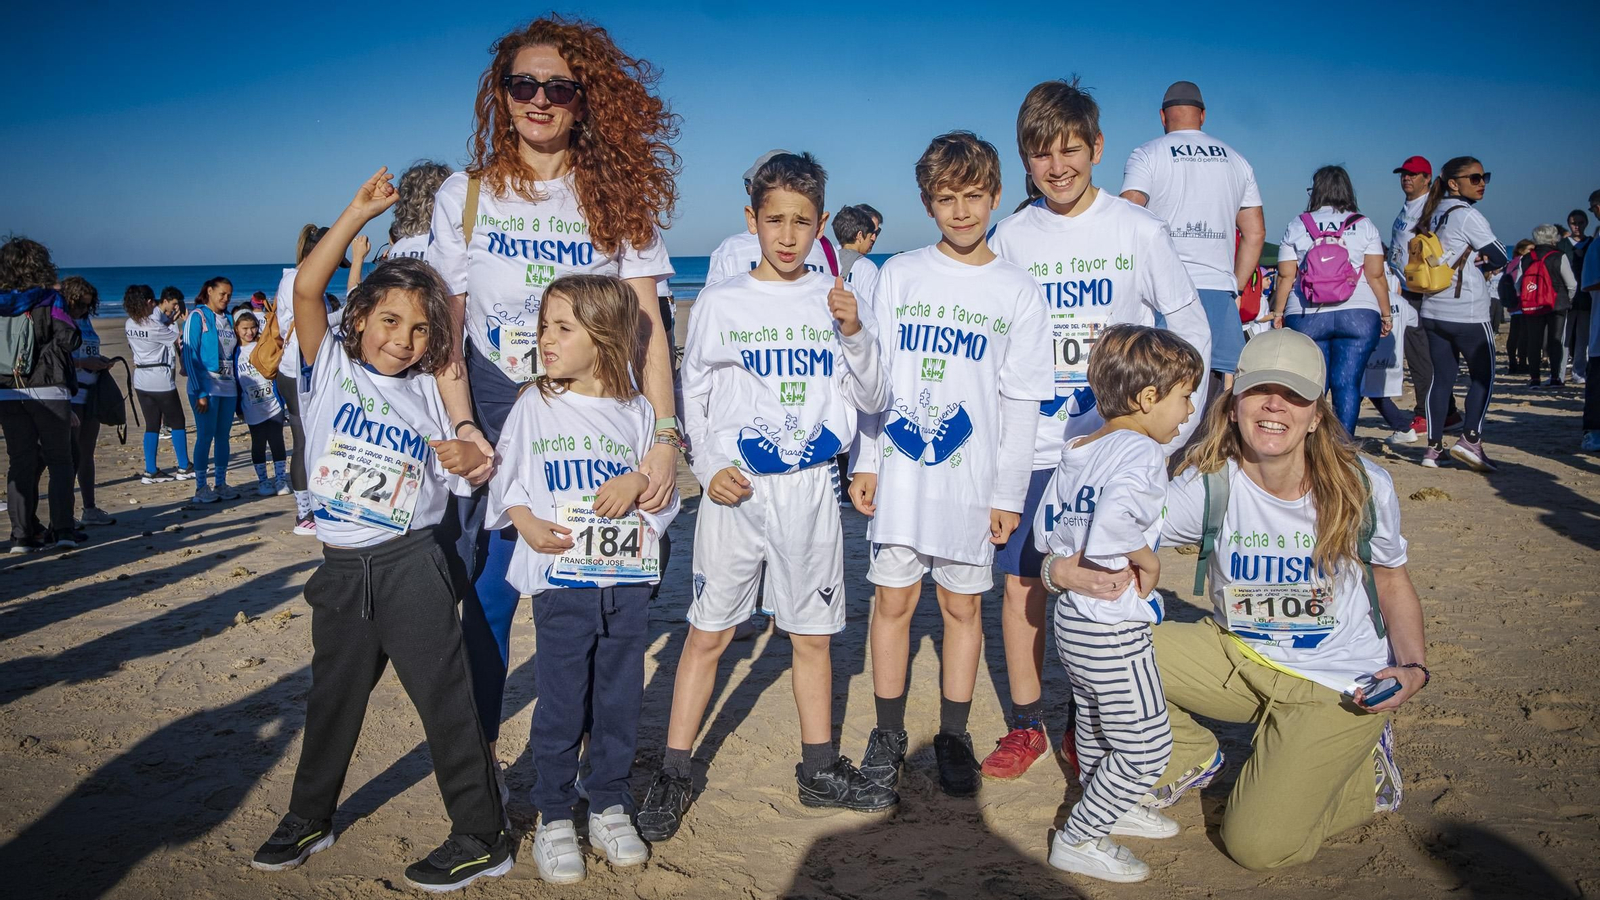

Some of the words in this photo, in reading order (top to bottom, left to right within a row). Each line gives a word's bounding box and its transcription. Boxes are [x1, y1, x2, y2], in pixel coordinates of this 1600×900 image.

[1170, 145, 1227, 157] KIABI
[533, 217, 540, 232] a
[548, 216, 587, 235] favor
[488, 232, 593, 266] AUTISMO
[1055, 261, 1063, 275] a
[1070, 257, 1107, 273] favor
[1115, 253, 1134, 271] del
[1042, 278, 1113, 309] TISMO
[493, 303, 525, 327] Cada
[937, 305, 945, 319] a
[953, 305, 988, 326] favor
[993, 316, 1012, 336] del
[729, 326, 778, 343] marcha
[785, 327, 793, 342] a
[801, 324, 835, 343] favor
[898, 323, 988, 361] AUTISMO
[253, 386, 271, 398] 279
[381, 402, 390, 415] a
[895, 397, 921, 426] Cada
[753, 416, 781, 447] Cada
[532, 433, 575, 455] marcha
[584, 435, 592, 450] a
[599, 434, 633, 459] favor
[343, 462, 387, 503] 72
[579, 525, 640, 557] 184
[1277, 534, 1285, 548] a
[560, 556, 604, 566] FRANCISCO
[1237, 597, 1325, 618] 1106
